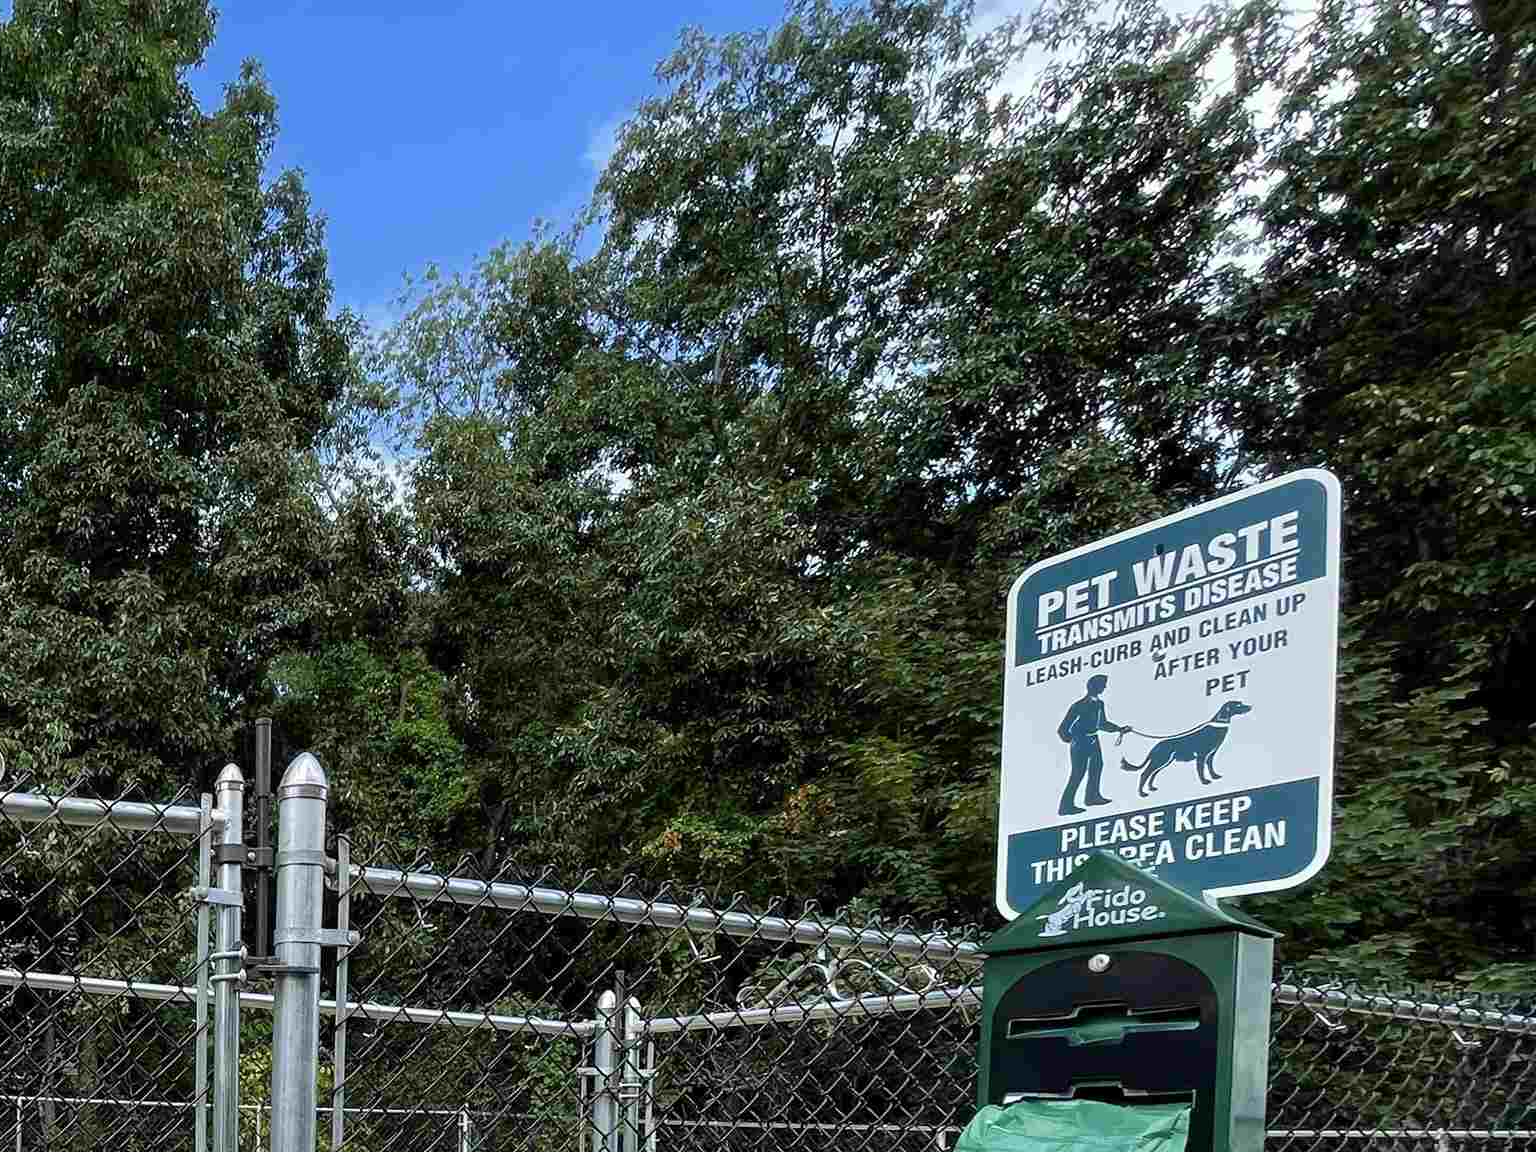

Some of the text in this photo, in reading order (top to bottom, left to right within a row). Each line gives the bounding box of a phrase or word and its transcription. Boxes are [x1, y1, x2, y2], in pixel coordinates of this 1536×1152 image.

[1037, 510, 1300, 628] PET WASTE
[1038, 557, 1298, 655] TRANSMITS DISEASE
[1025, 592, 1307, 688] LEASH-CURB AND CLEAN UP
[1154, 629, 1289, 681] AFTER YOUR
[1205, 669, 1252, 698] PET
[1061, 795, 1252, 853] PLEASE KEEP
[1109, 839, 1175, 873] REA
[1184, 819, 1287, 861] CLEAN
[1085, 884, 1146, 910] Fido
